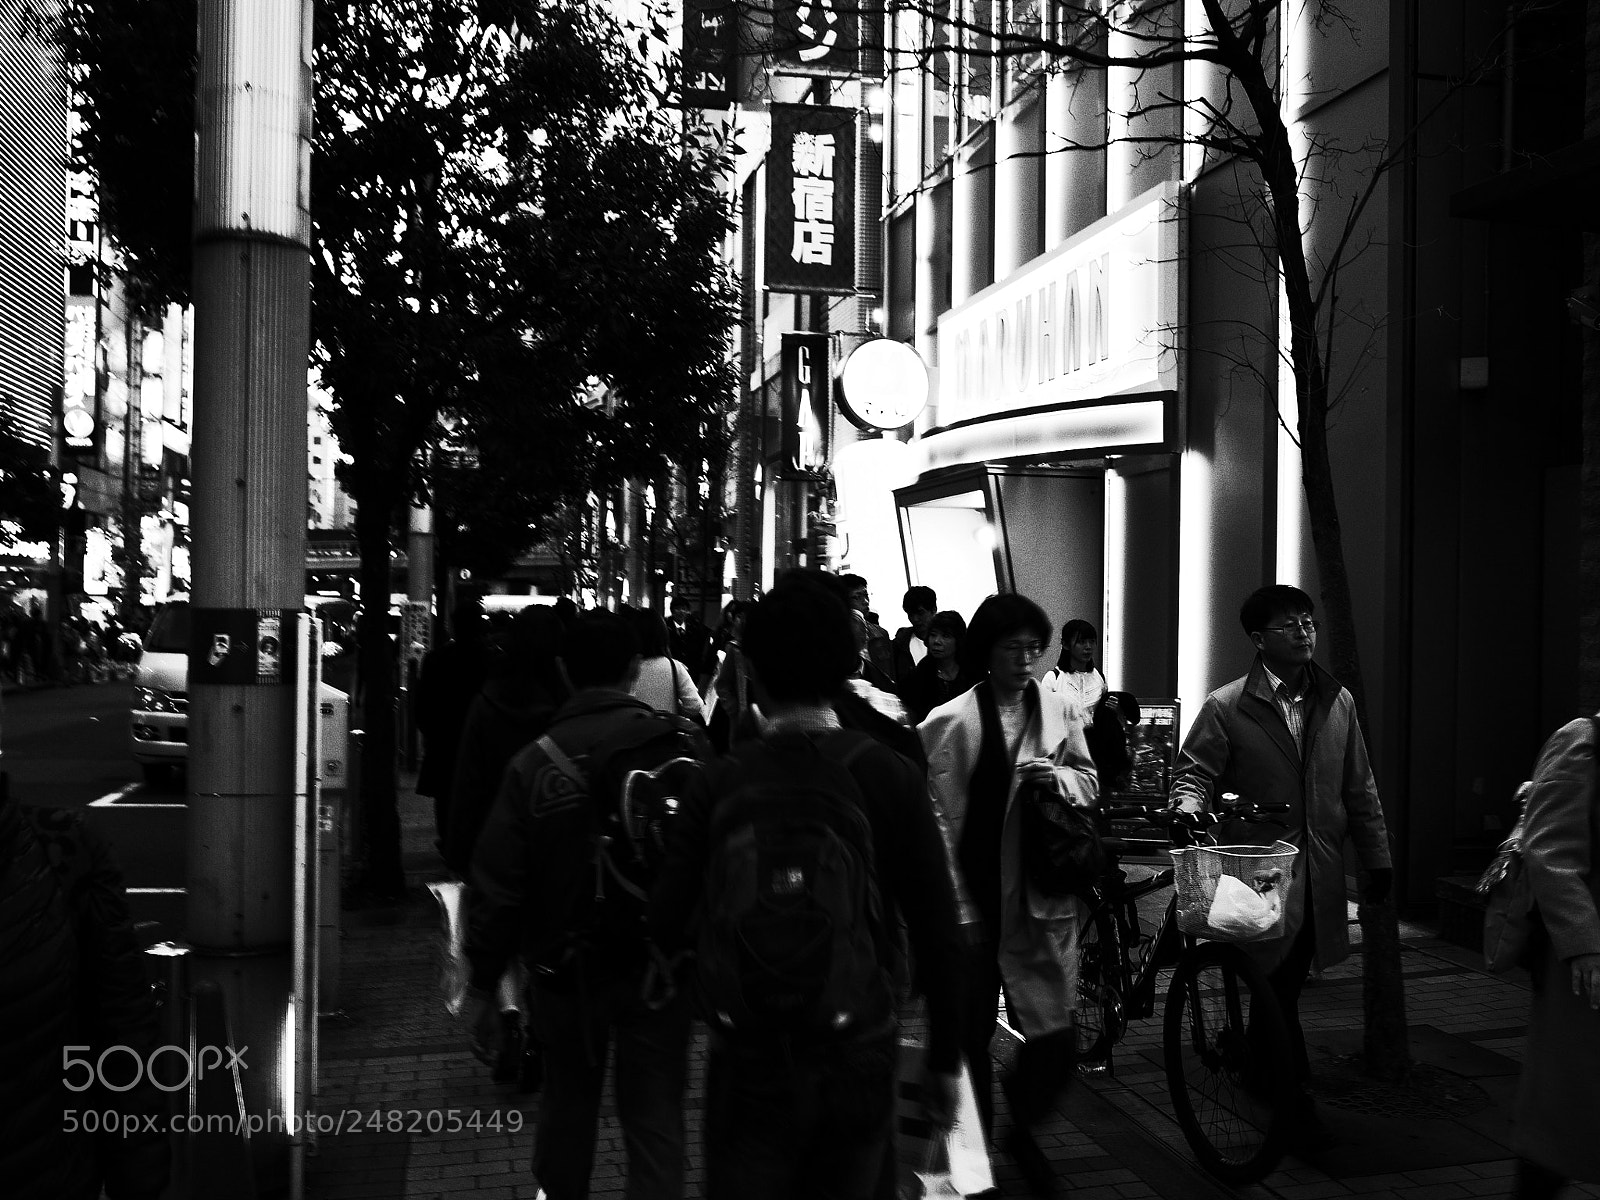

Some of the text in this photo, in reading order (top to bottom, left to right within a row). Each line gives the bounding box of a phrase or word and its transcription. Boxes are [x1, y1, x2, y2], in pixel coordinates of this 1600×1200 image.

[791, 132, 836, 266] 新宿店
[955, 252, 1110, 400] MARUHAN
